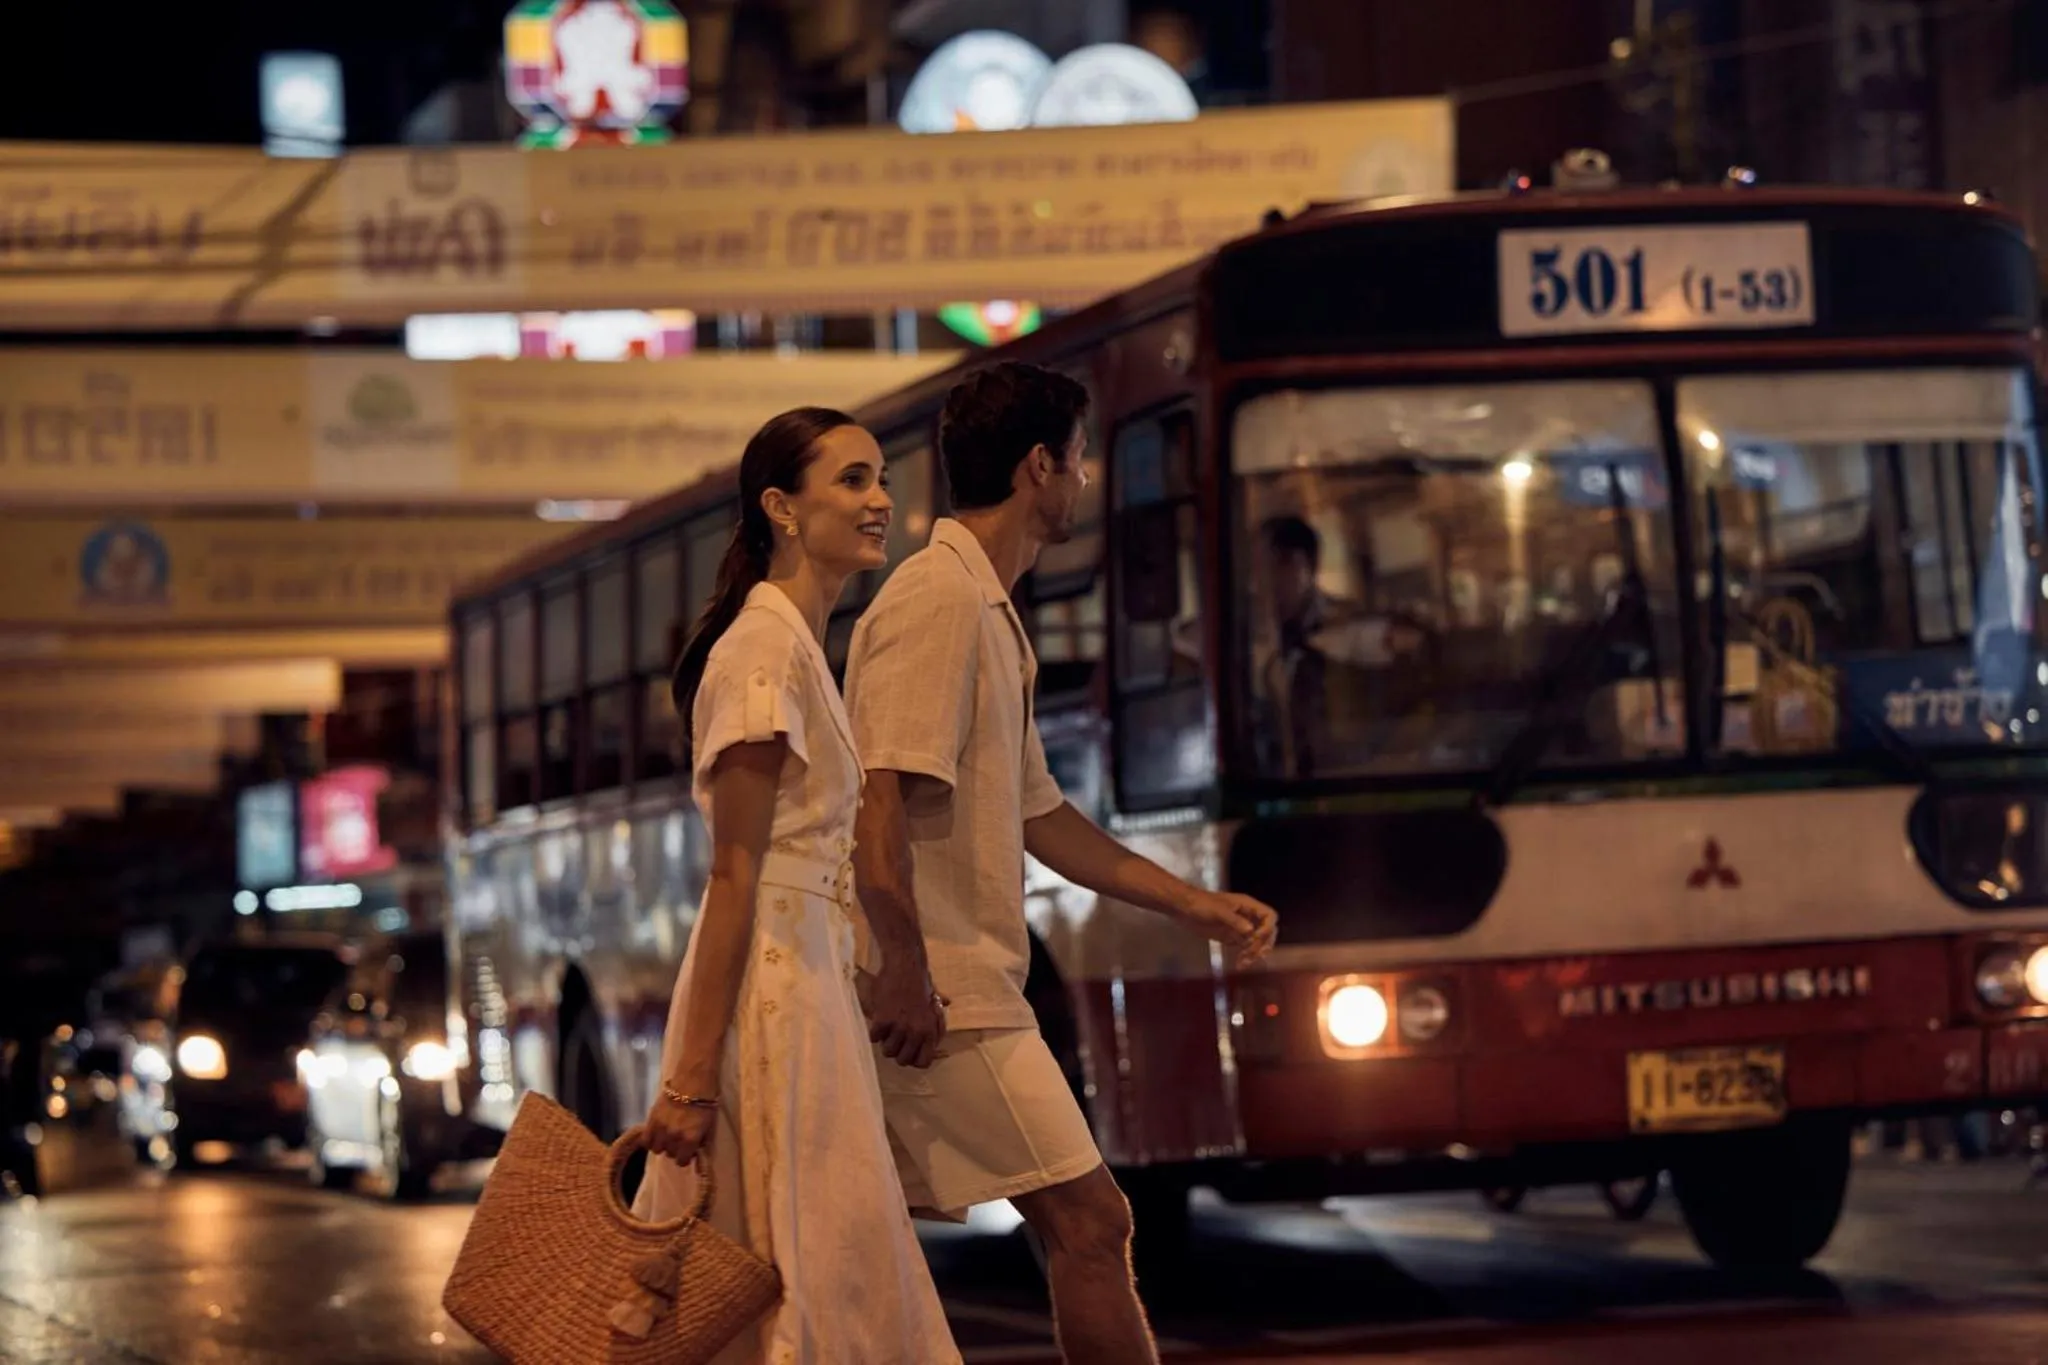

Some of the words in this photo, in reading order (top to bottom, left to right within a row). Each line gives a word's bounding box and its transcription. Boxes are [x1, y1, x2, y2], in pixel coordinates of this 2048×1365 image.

[1529, 244, 1646, 319] 501
[1682, 265, 1803, 313] (1-53)
[1559, 966, 1870, 1016] MITSUBISHI
